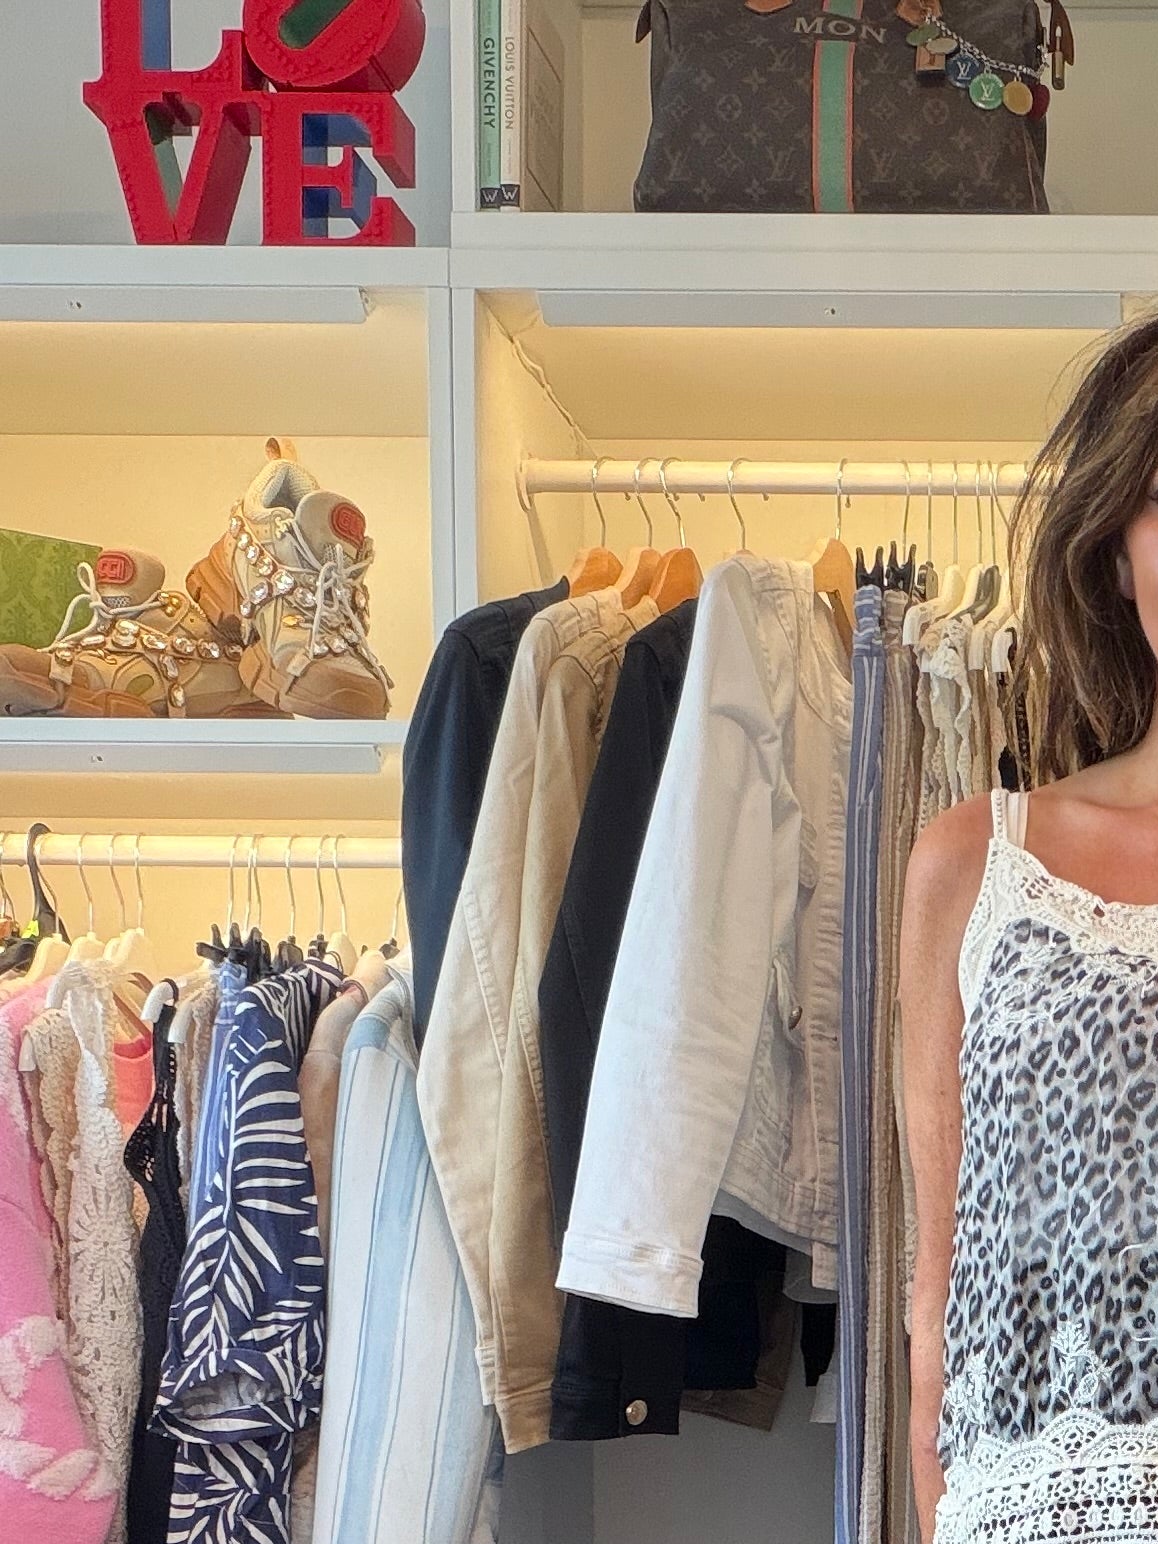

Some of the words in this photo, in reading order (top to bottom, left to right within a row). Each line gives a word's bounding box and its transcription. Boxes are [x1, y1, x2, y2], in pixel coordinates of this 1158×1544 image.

[793, 16, 887, 44] MON
[505, 36, 515, 71] LOUIS
[483, 37, 496, 129] GIVENCHY
[505, 76, 515, 130] VUITTON
